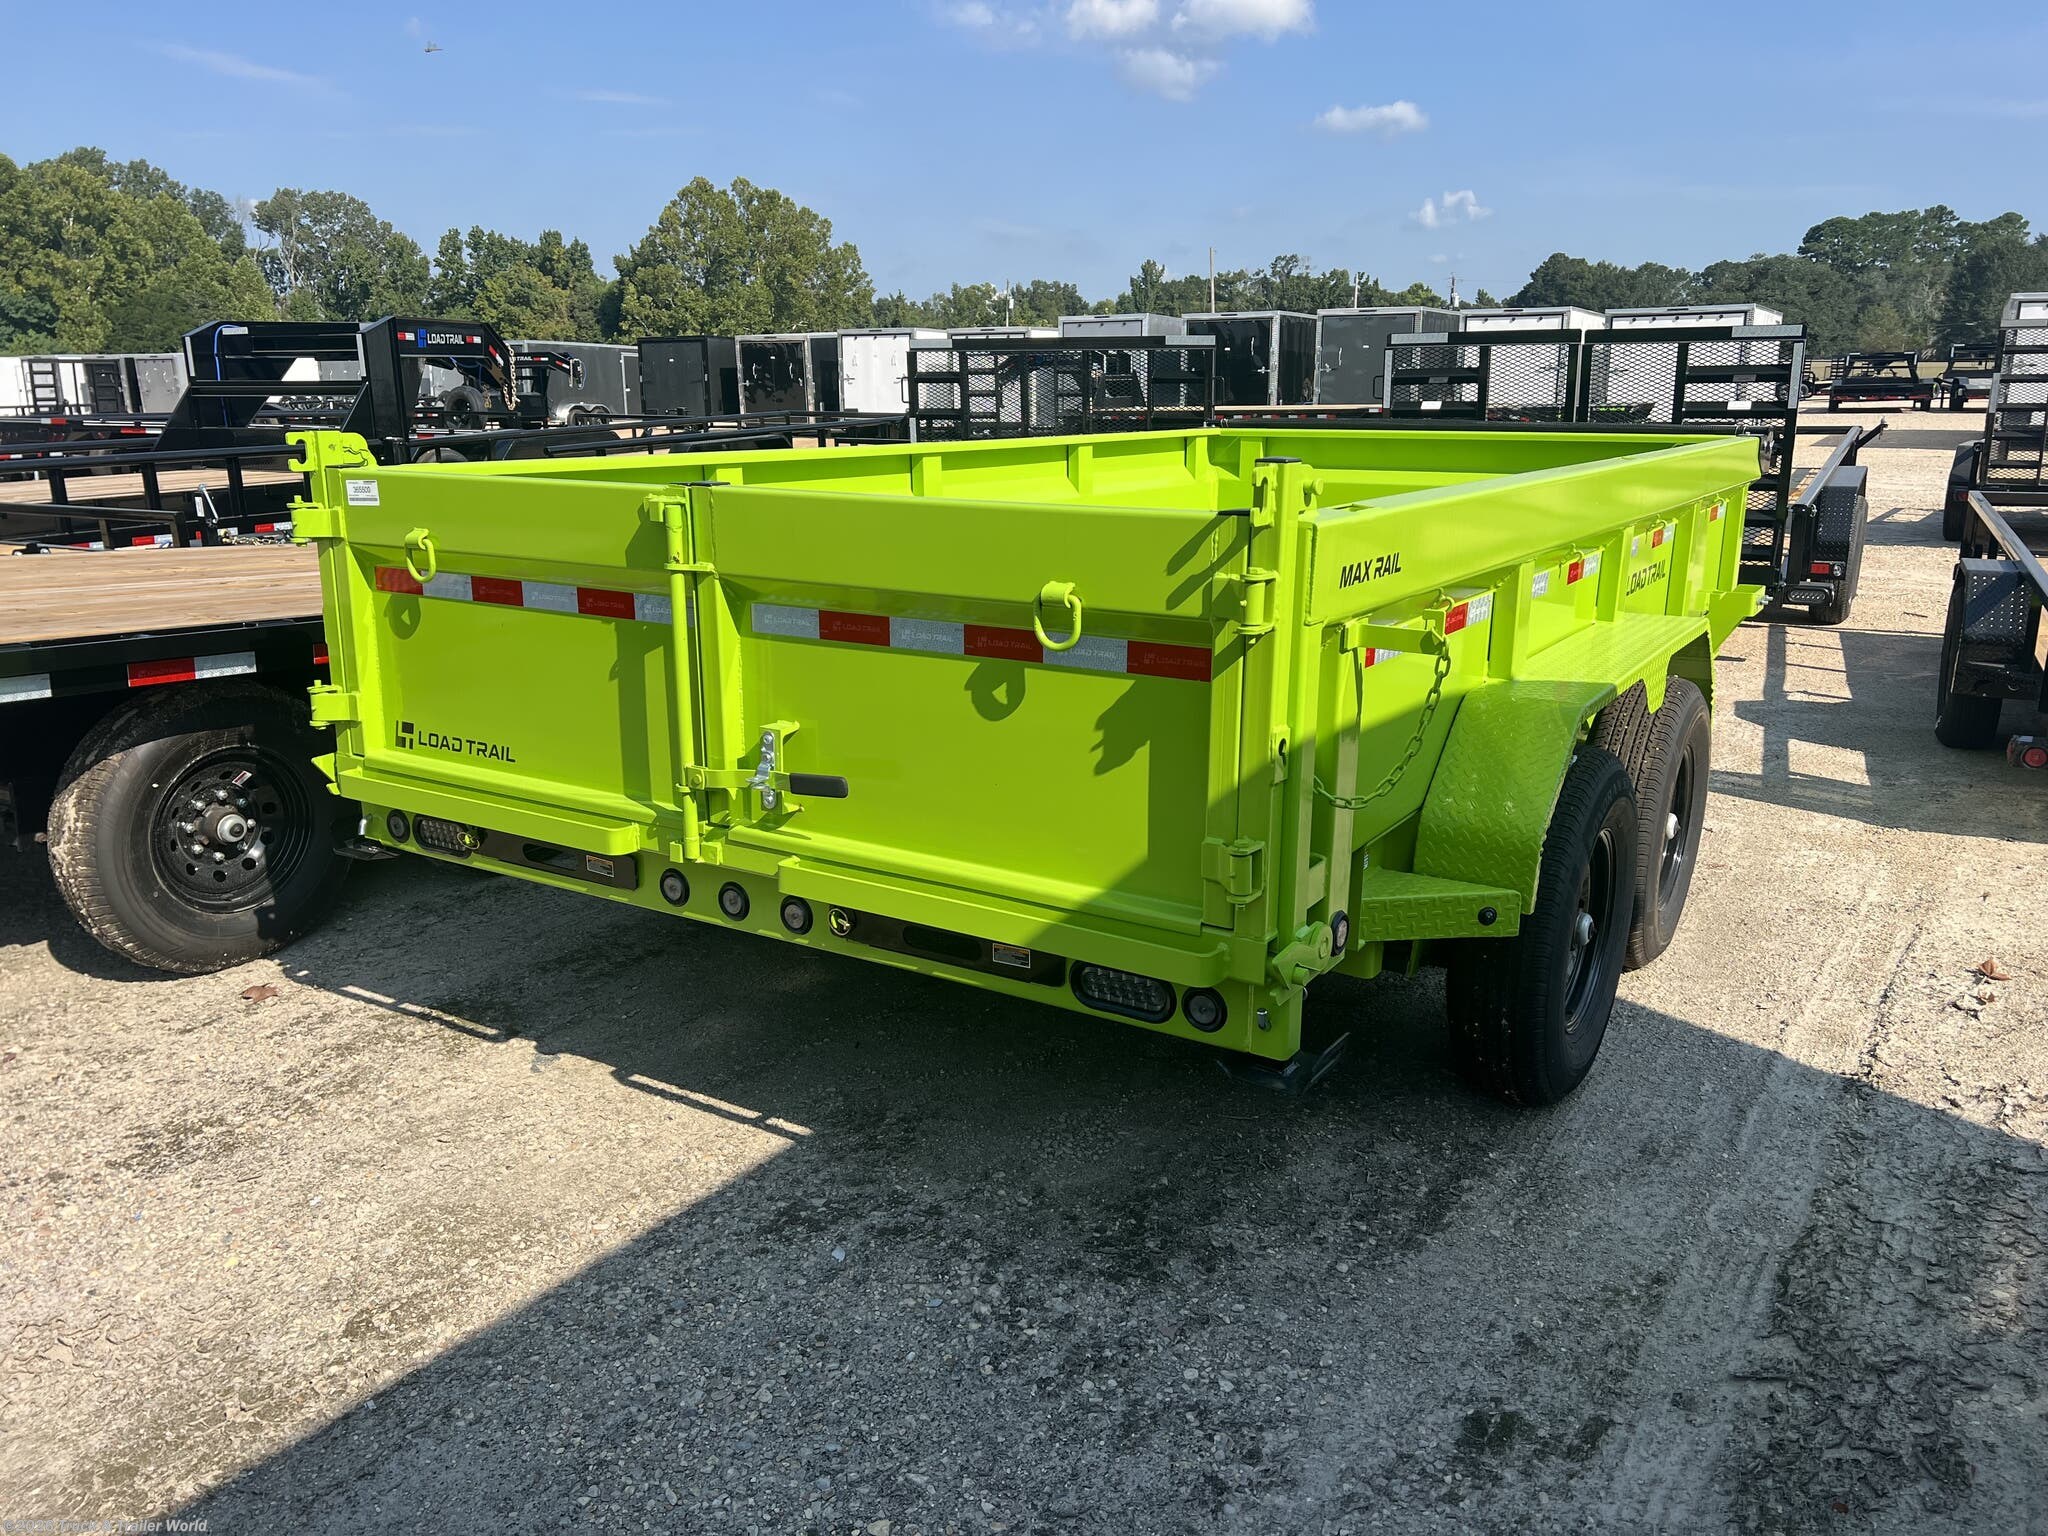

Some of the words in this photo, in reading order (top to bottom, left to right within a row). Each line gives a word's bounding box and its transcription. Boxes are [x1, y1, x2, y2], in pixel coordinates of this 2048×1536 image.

[1339, 558, 1374, 590] MAX
[1373, 552, 1402, 580] RAIL
[418, 730, 463, 753] LOAD
[466, 739, 516, 763] TRAIL
